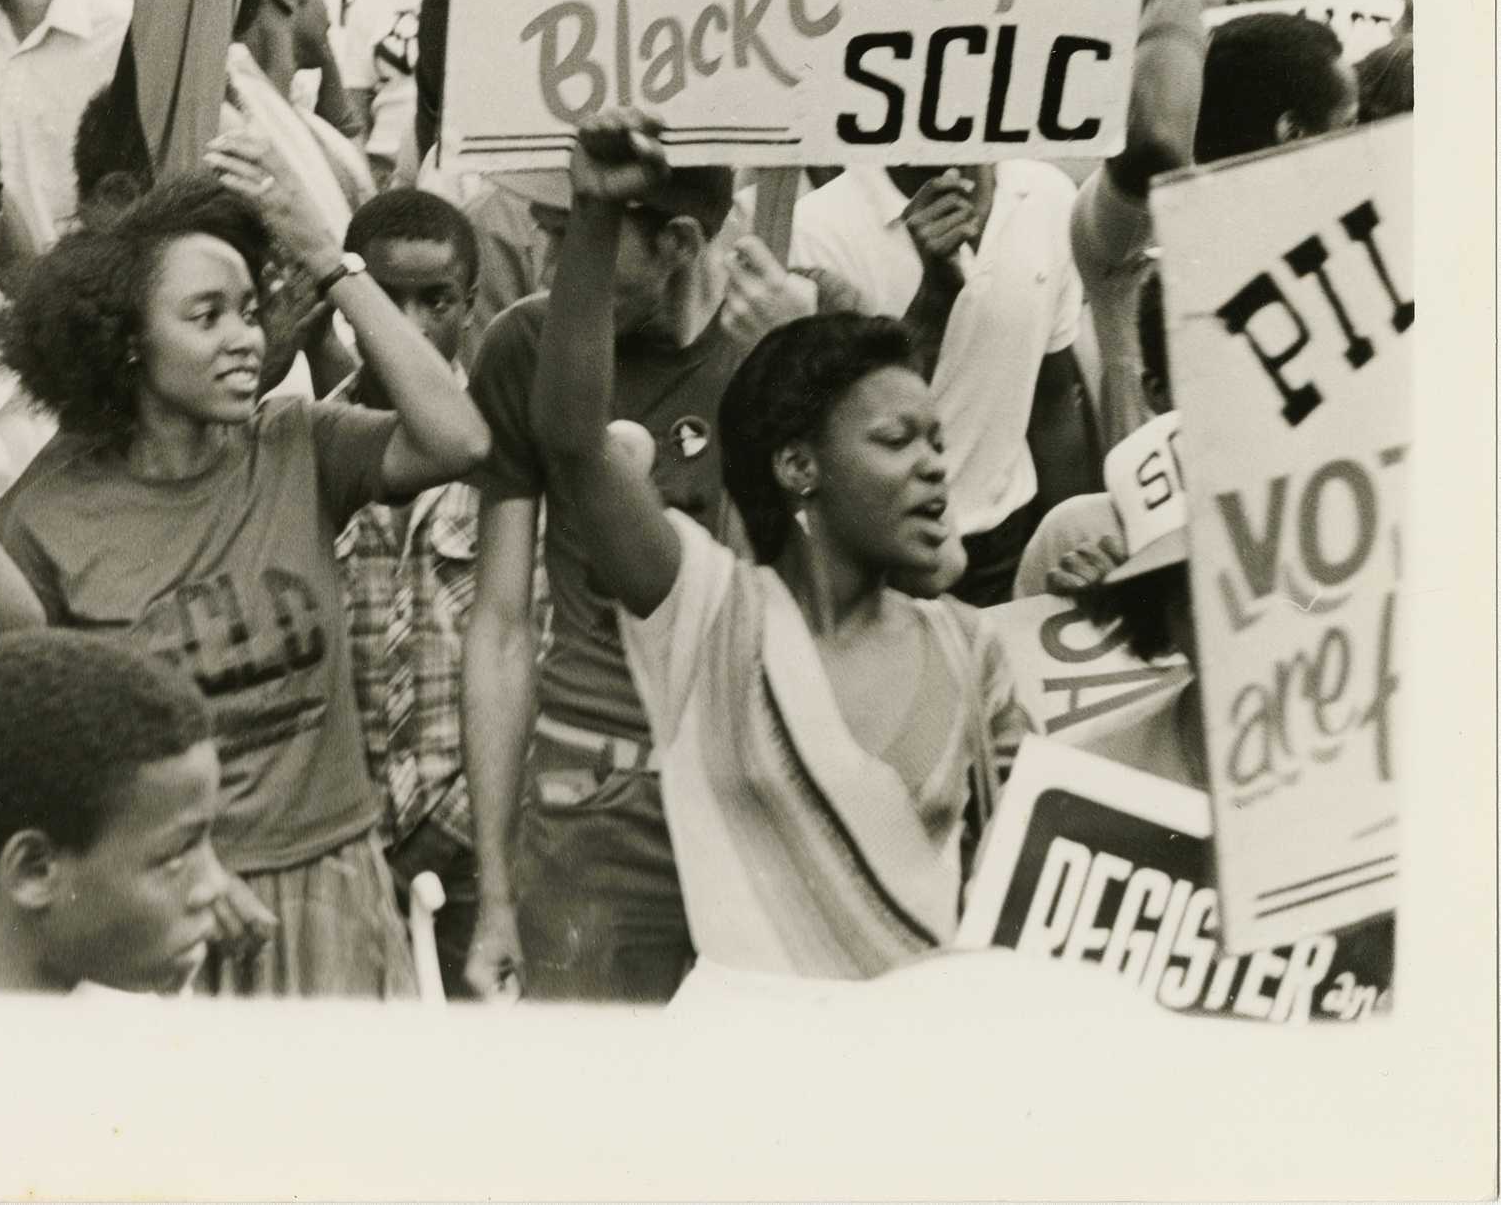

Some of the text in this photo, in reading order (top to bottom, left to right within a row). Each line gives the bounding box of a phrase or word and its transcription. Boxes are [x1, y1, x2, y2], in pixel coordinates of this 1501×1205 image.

[836, 24, 1112, 146] SCLC
[1215, 445, 1409, 599] VO
[1016, 835, 1337, 1025] REGISTER
